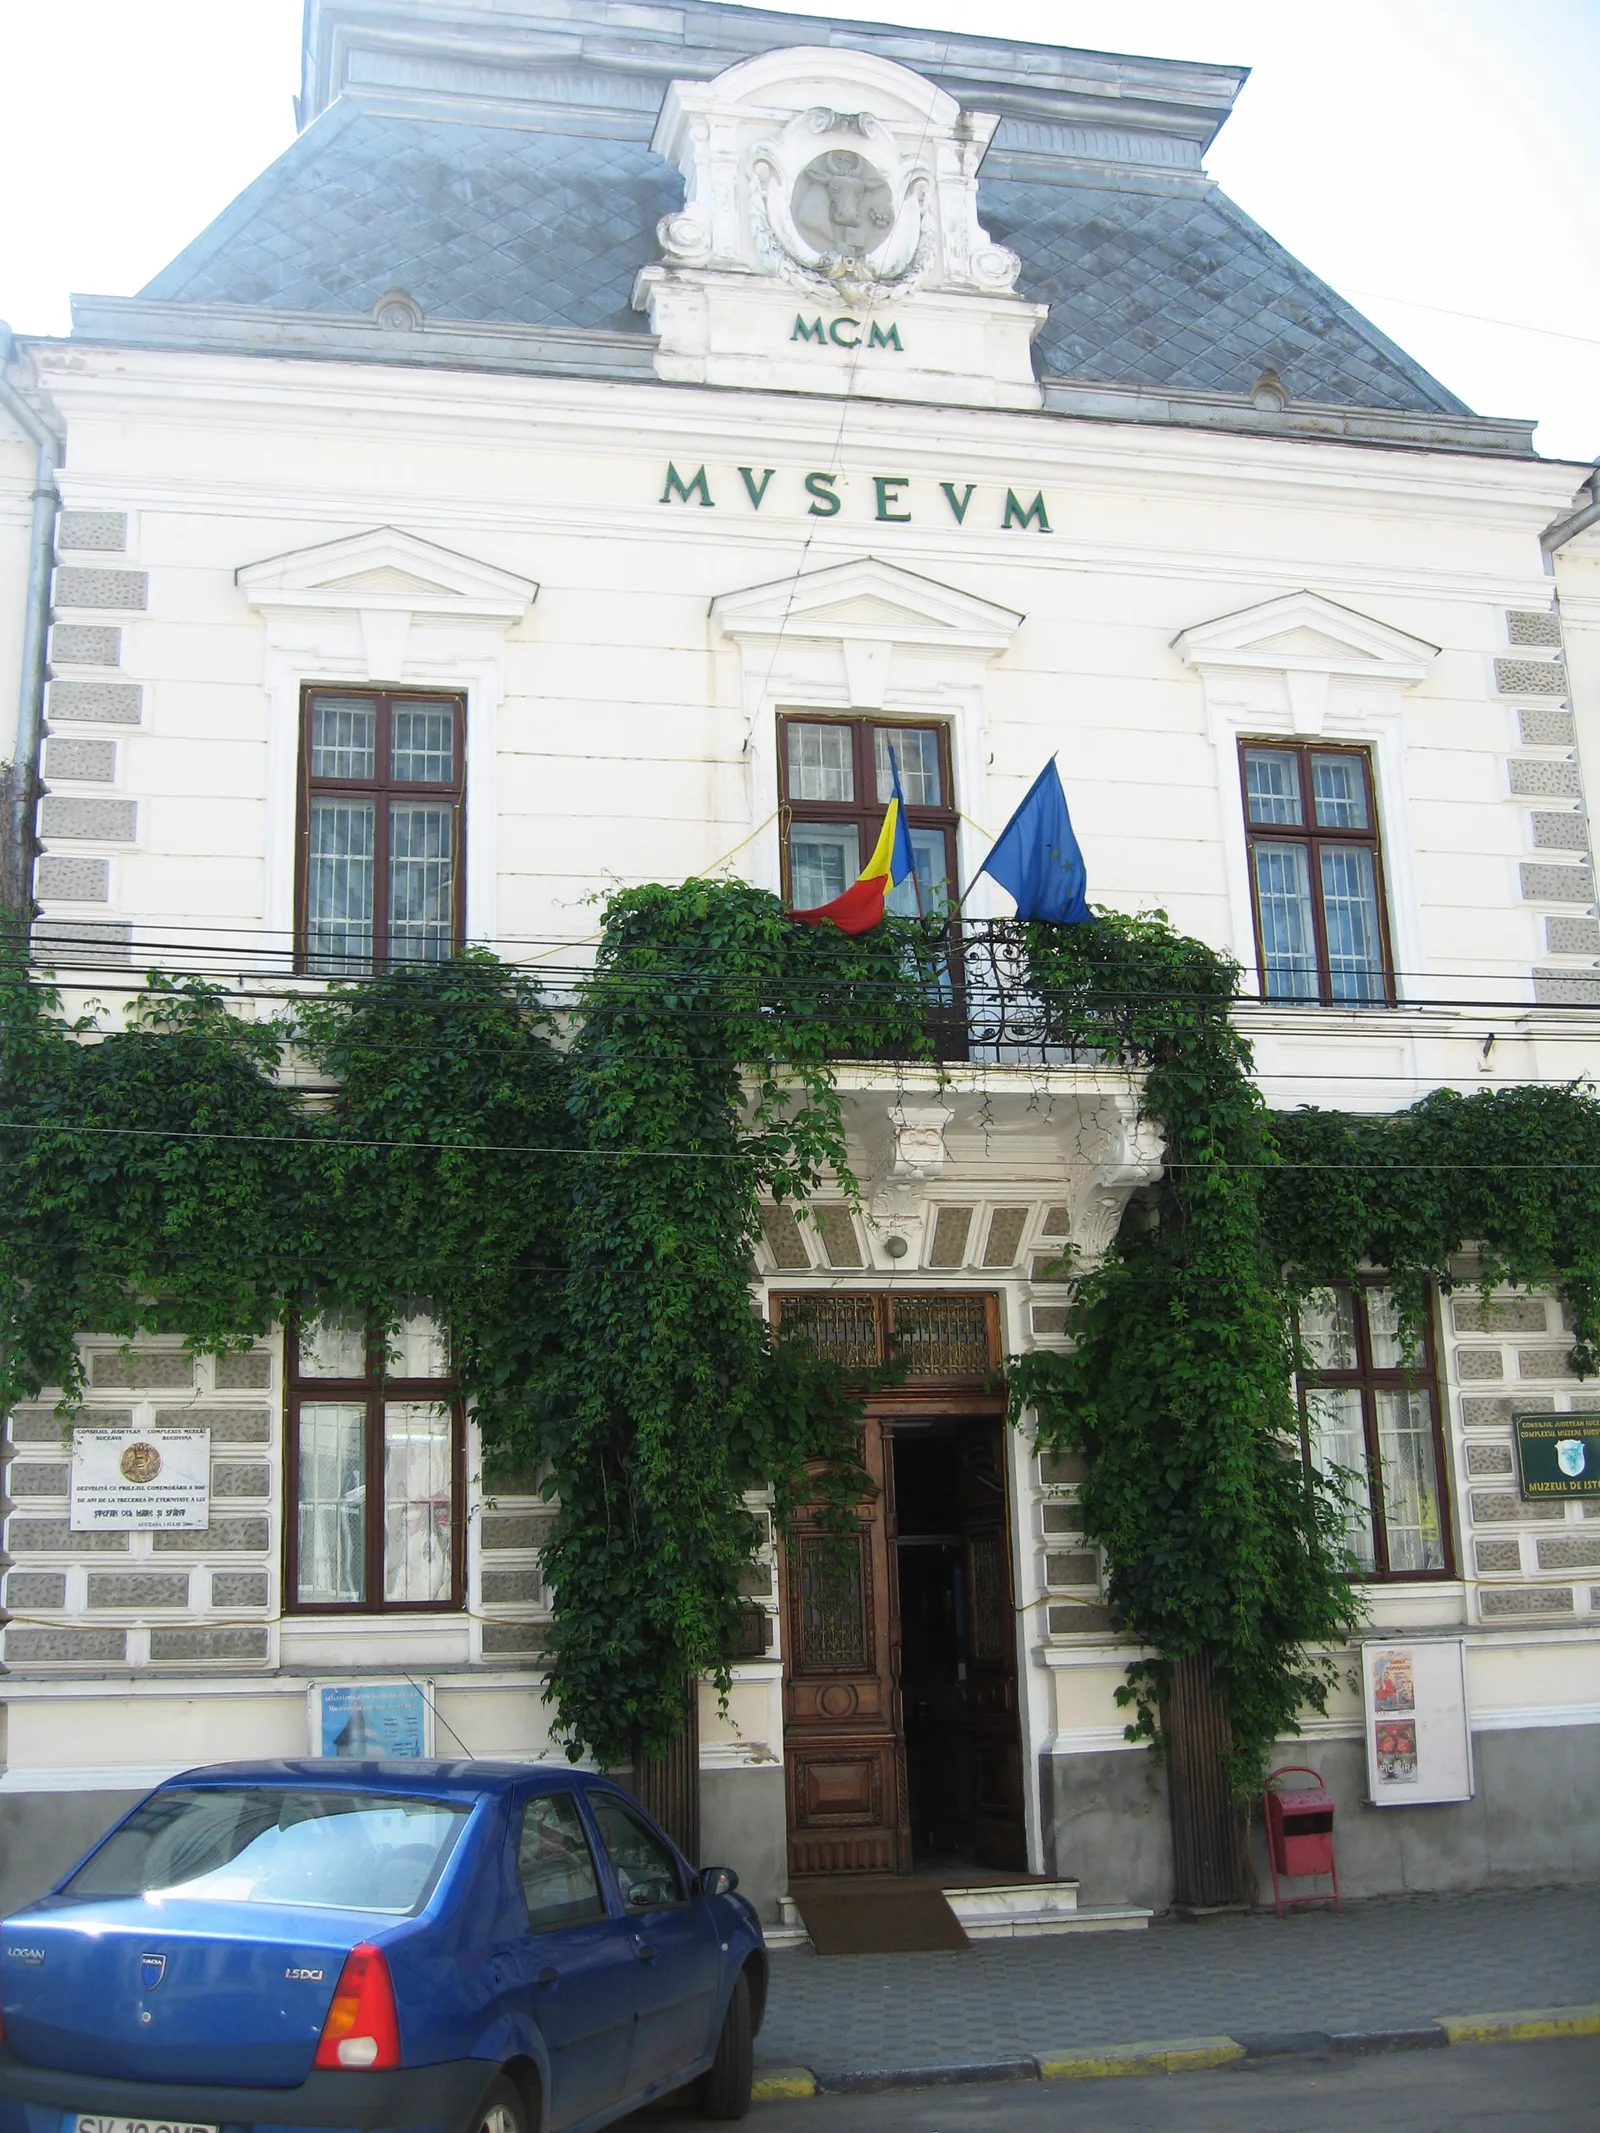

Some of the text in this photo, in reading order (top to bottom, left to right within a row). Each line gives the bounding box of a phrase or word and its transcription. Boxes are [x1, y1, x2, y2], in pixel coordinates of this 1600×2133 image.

[789, 312, 905, 352] MCM
[658, 459, 1054, 534] MVSEVM
[1529, 1482, 1568, 1491] MUZEUL
[1570, 1481, 1582, 1490] DE
[8, 1946, 46, 1960] LOGAN
